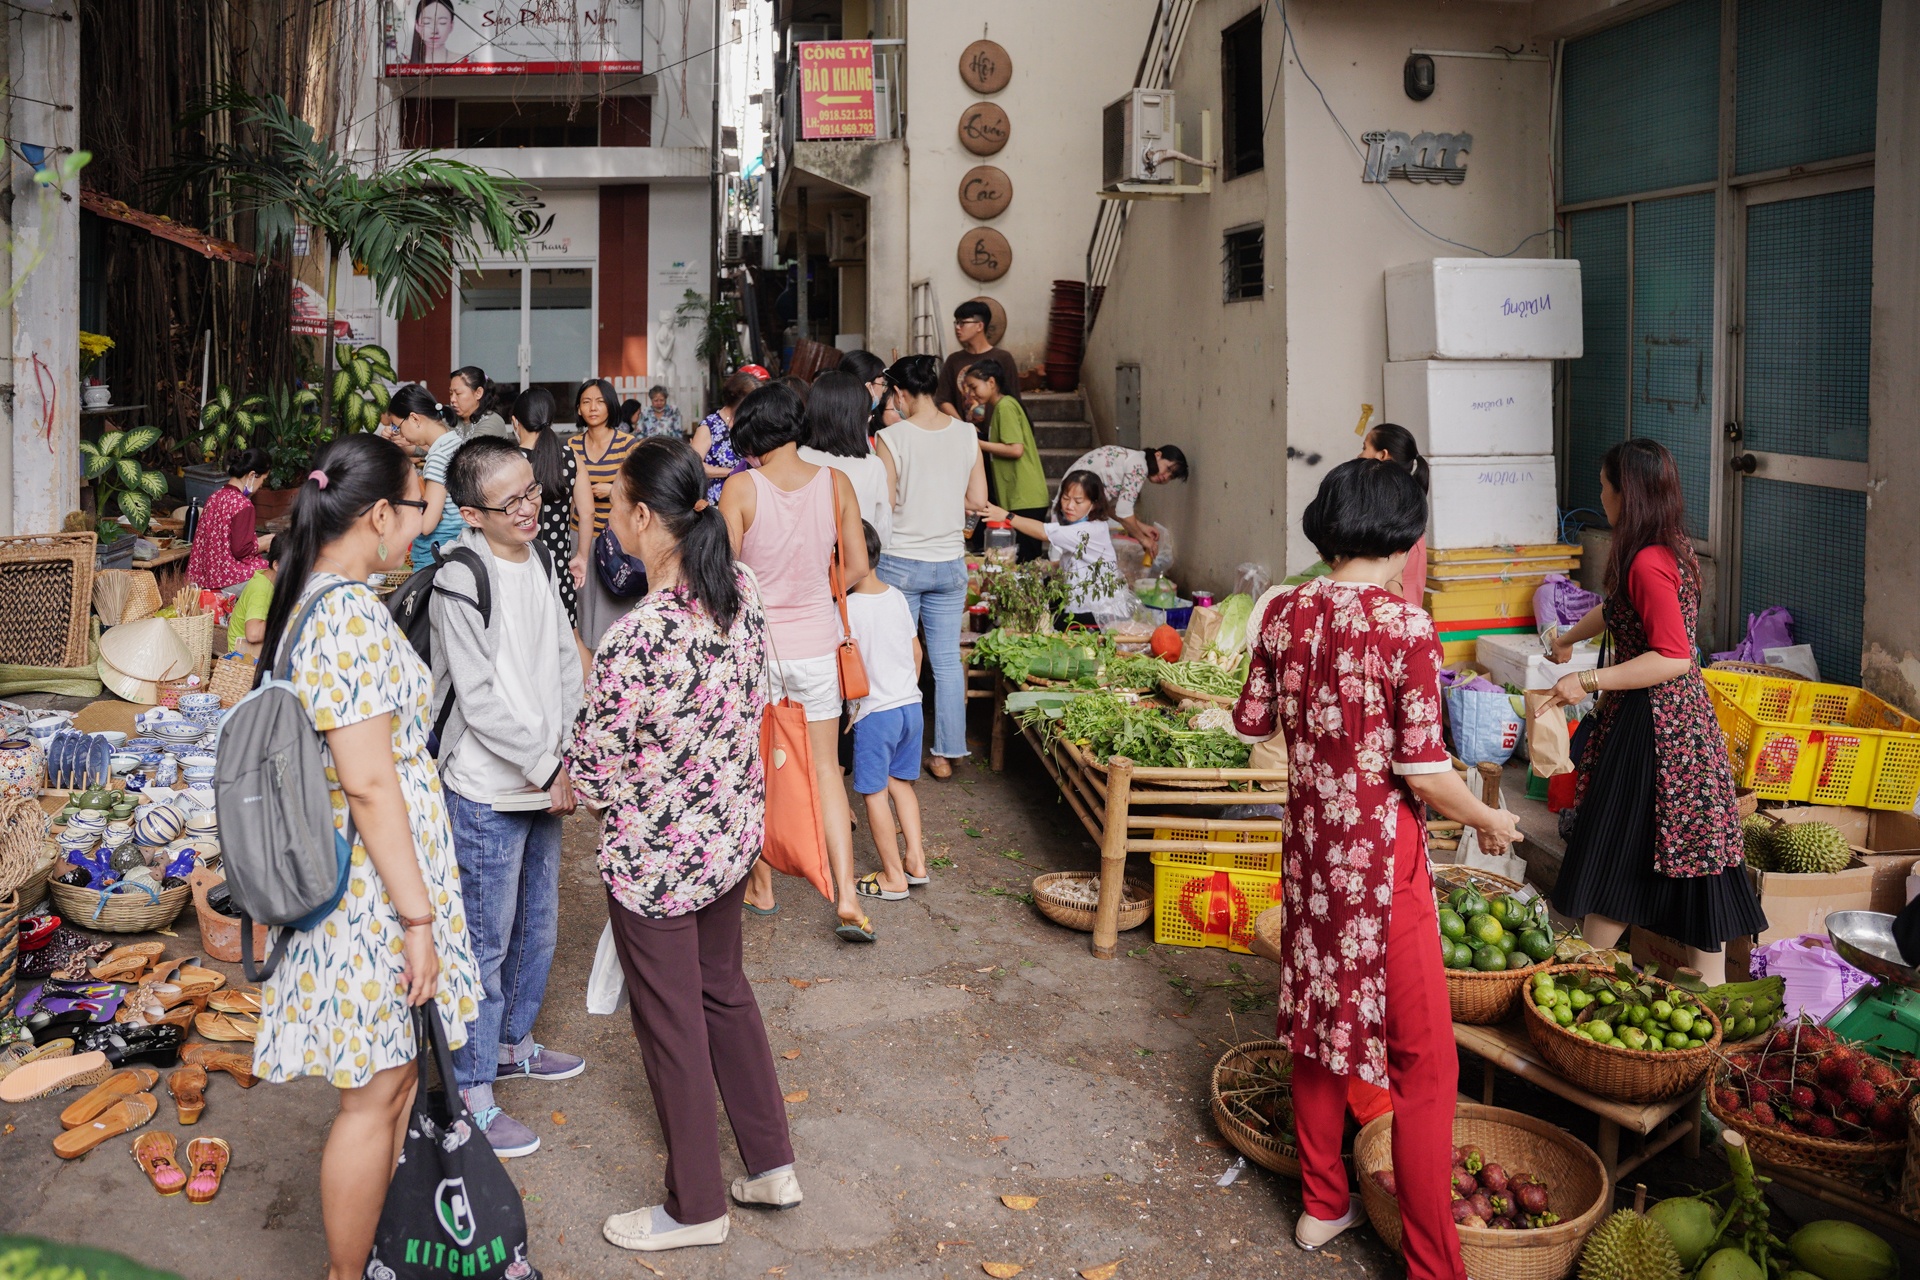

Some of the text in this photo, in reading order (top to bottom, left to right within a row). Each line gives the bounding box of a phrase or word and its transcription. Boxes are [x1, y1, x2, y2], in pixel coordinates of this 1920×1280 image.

[804, 44, 869, 60] CÔNG TY
[804, 61, 873, 92] BẢO KHANG
[806, 117, 820, 128] LH:
[819, 109, 873, 121] 0918.521.331
[820, 123, 874, 135] 0914.969.792
[963, 178, 1003, 202] Các
[970, 238, 998, 270] Bà
[405, 1235, 507, 1277] KITCHEN
